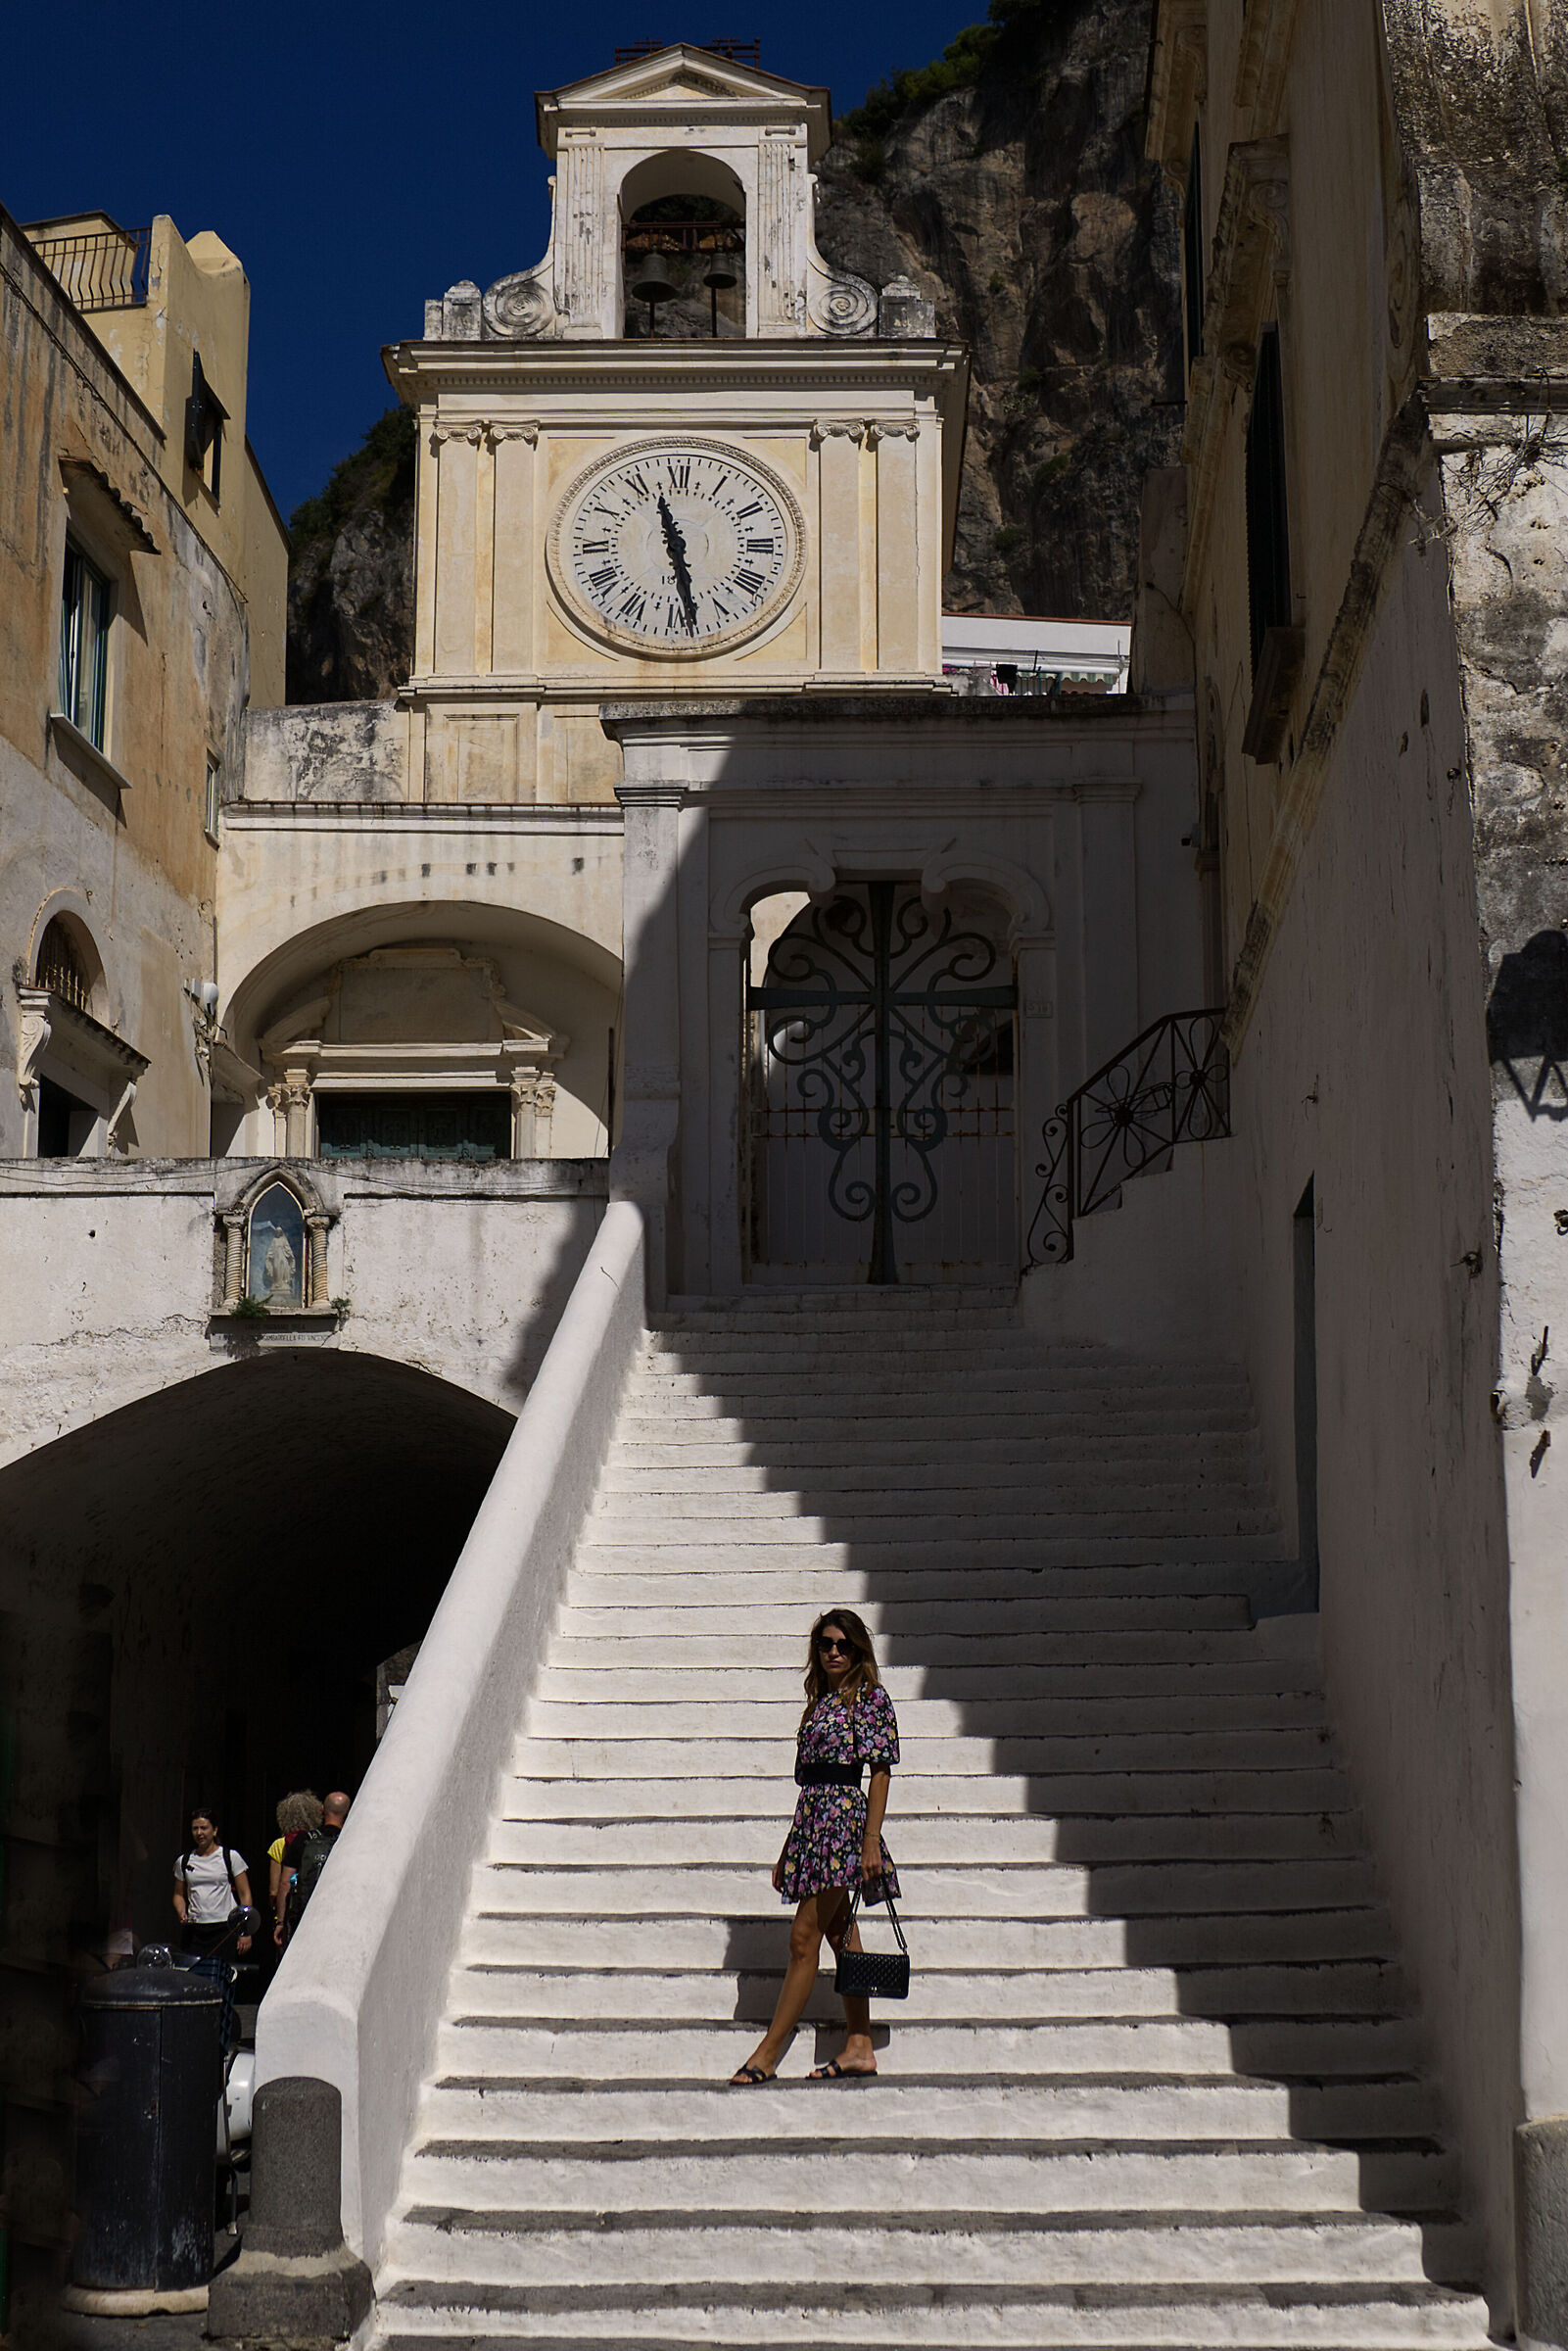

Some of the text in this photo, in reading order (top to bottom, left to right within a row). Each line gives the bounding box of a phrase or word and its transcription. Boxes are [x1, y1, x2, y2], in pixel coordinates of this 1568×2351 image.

[624, 472, 650, 499] XI
[667, 465, 691, 489] XII
[594, 502, 620, 520] X
[583, 538, 609, 554] IX
[746, 538, 774, 554] III
